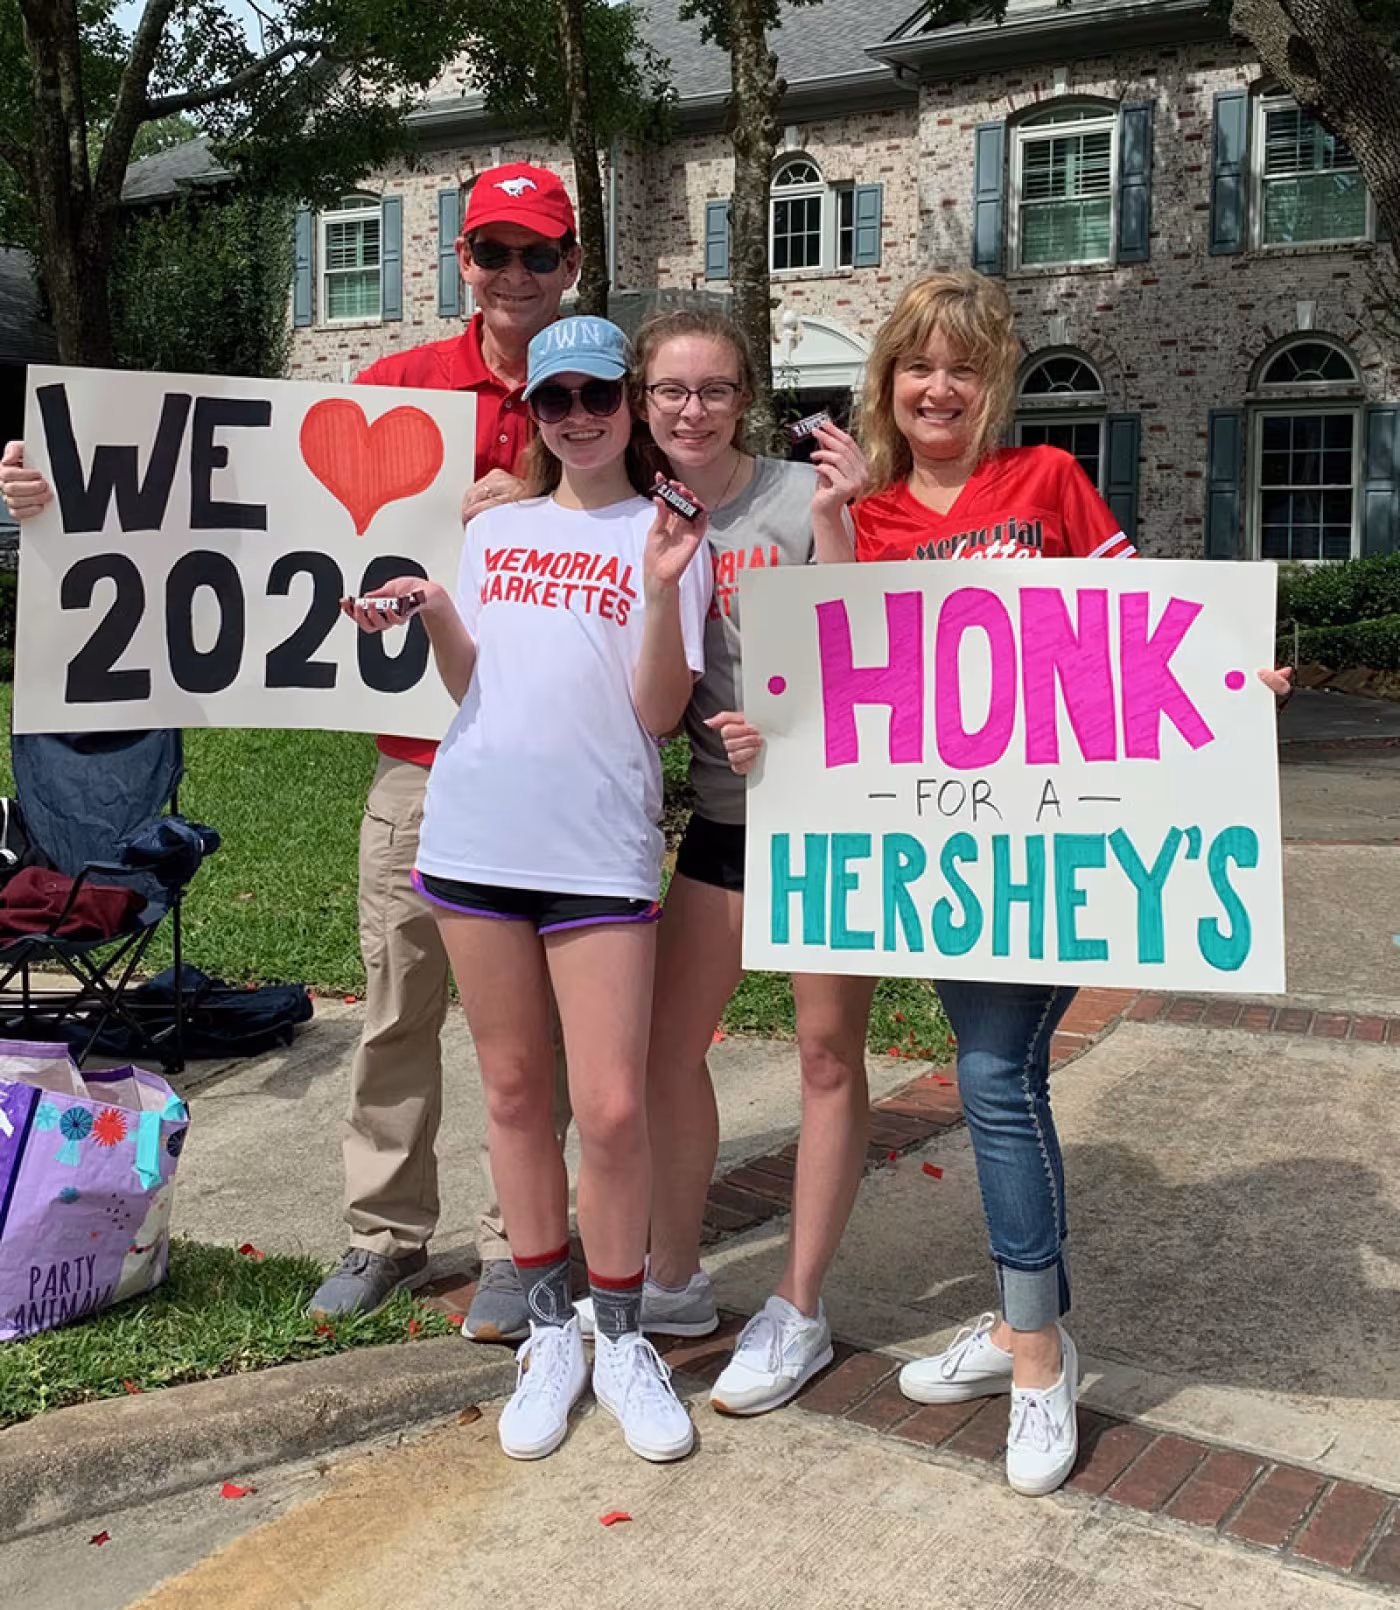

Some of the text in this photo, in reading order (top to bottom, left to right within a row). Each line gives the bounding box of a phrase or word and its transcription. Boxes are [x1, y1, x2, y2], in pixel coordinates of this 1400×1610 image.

[539, 319, 601, 354] JWN
[36, 383, 272, 533] WE
[485, 548, 637, 599] MEMORIAL
[60, 549, 431, 704] 2020
[815, 587, 1215, 770] HONK
[916, 778, 1061, 822] FOR A
[770, 825, 1259, 971] HERSHEY'S
[29, 1254, 97, 1301] PARTY
